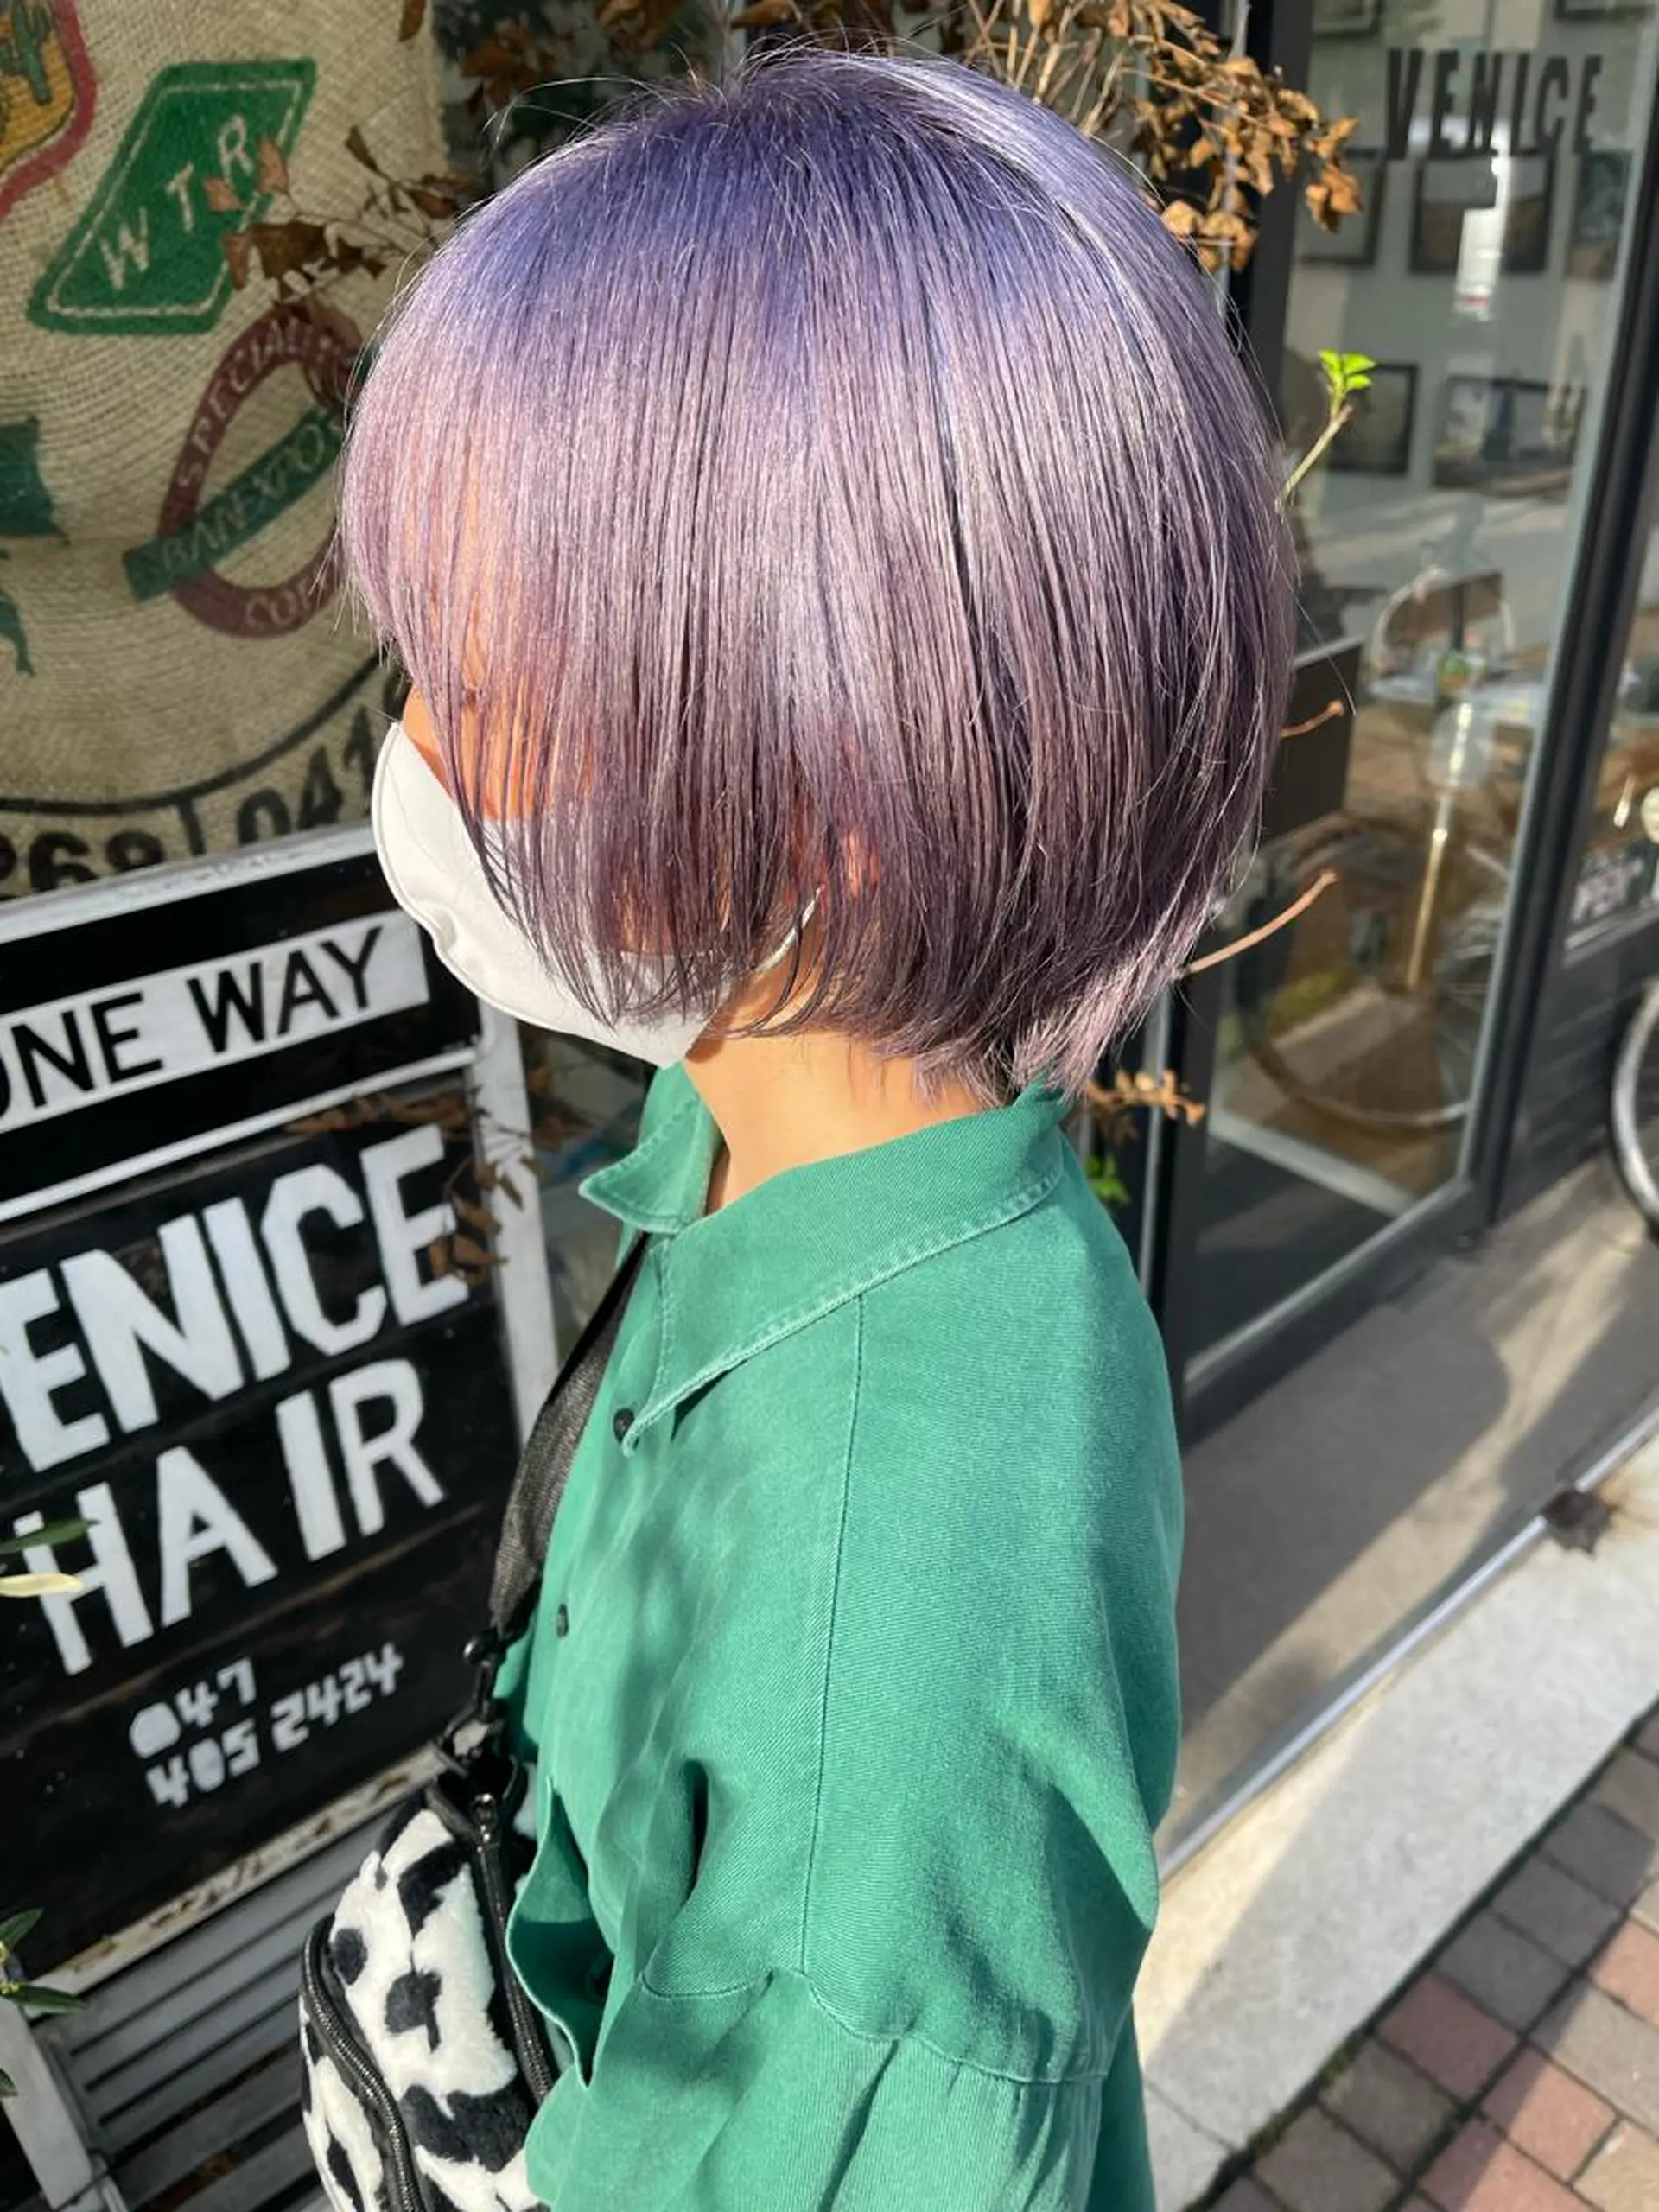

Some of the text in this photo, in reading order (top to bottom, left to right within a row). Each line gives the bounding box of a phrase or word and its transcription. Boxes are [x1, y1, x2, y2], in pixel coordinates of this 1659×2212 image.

[1388, 48, 1603, 160] VENICE
[0, 925, 383, 1116] NE WAY
[0, 1124, 471, 1473] ENICE
[12, 1357, 446, 1676] HAIR
[130, 1656, 257, 1758] 047
[145, 1642, 404, 1808] 405 2424
